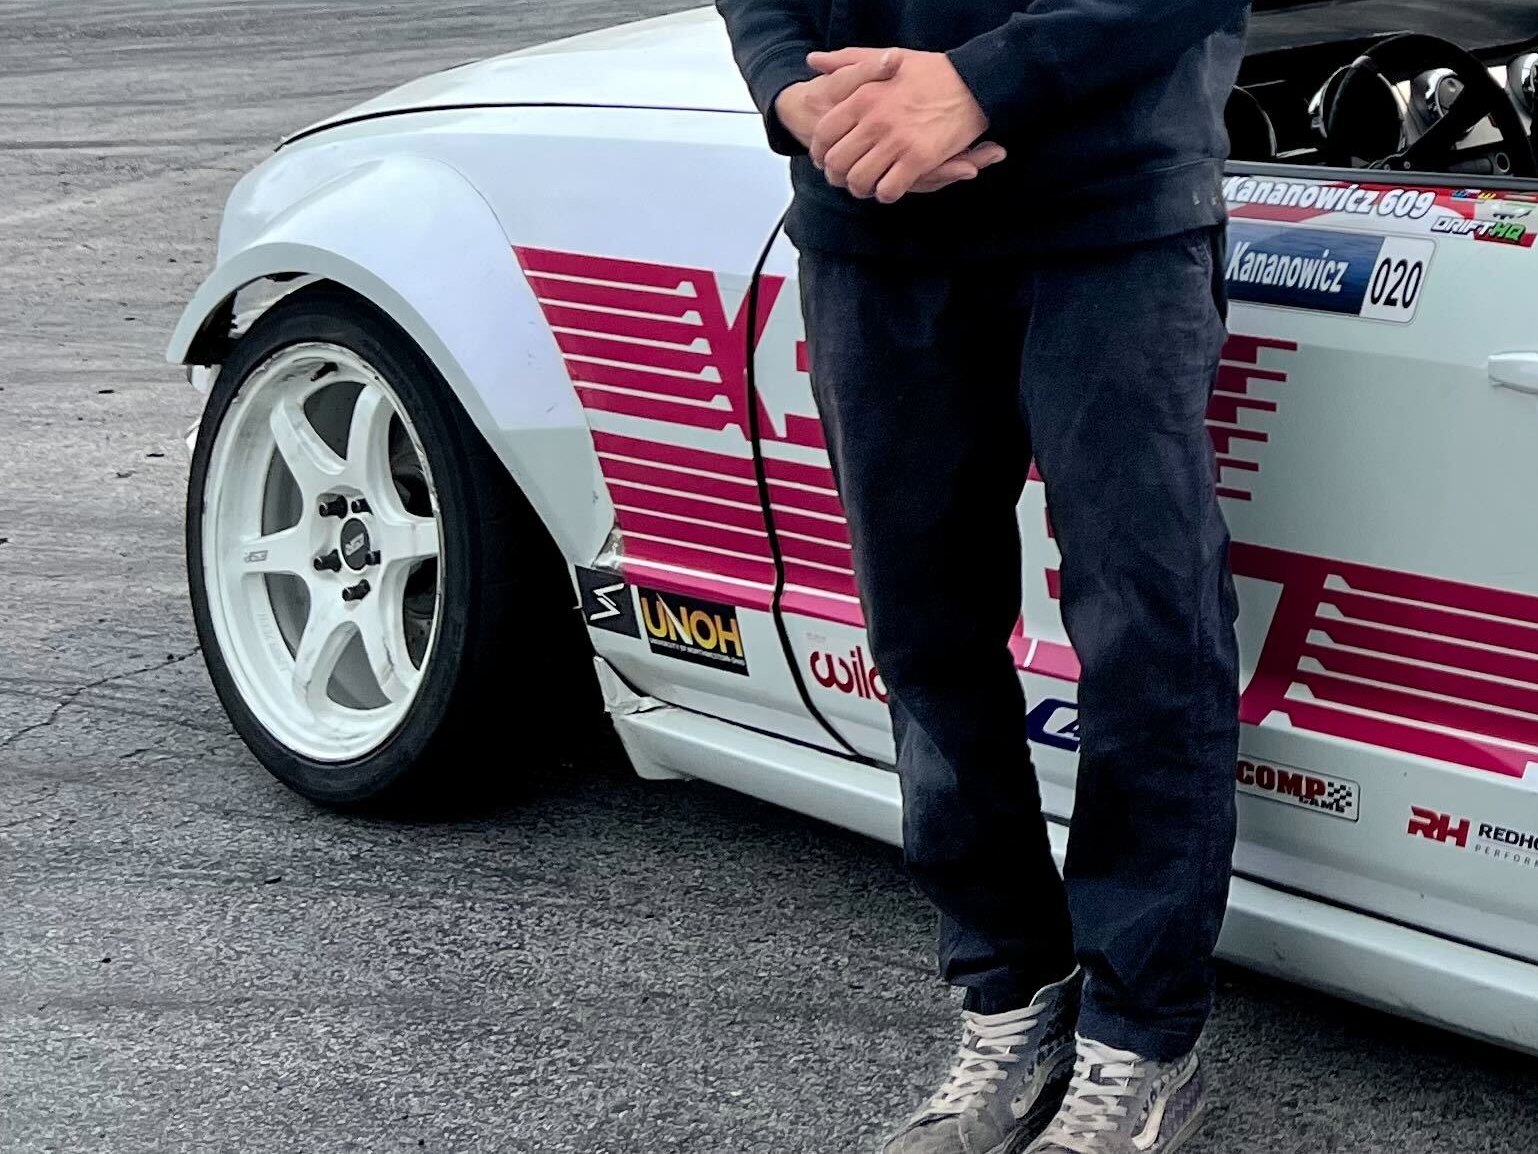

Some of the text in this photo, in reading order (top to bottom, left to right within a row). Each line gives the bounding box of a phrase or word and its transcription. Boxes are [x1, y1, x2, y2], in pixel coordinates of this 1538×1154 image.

[1223, 176, 1380, 214] Kananowicz
[1378, 189, 1437, 219] 609
[1226, 240, 1349, 293] Kananowicz
[1370, 257, 1423, 309] 020
[641, 593, 743, 658] UNOH
[1236, 759, 1327, 800] COMP
[1407, 805, 1471, 848] RH
